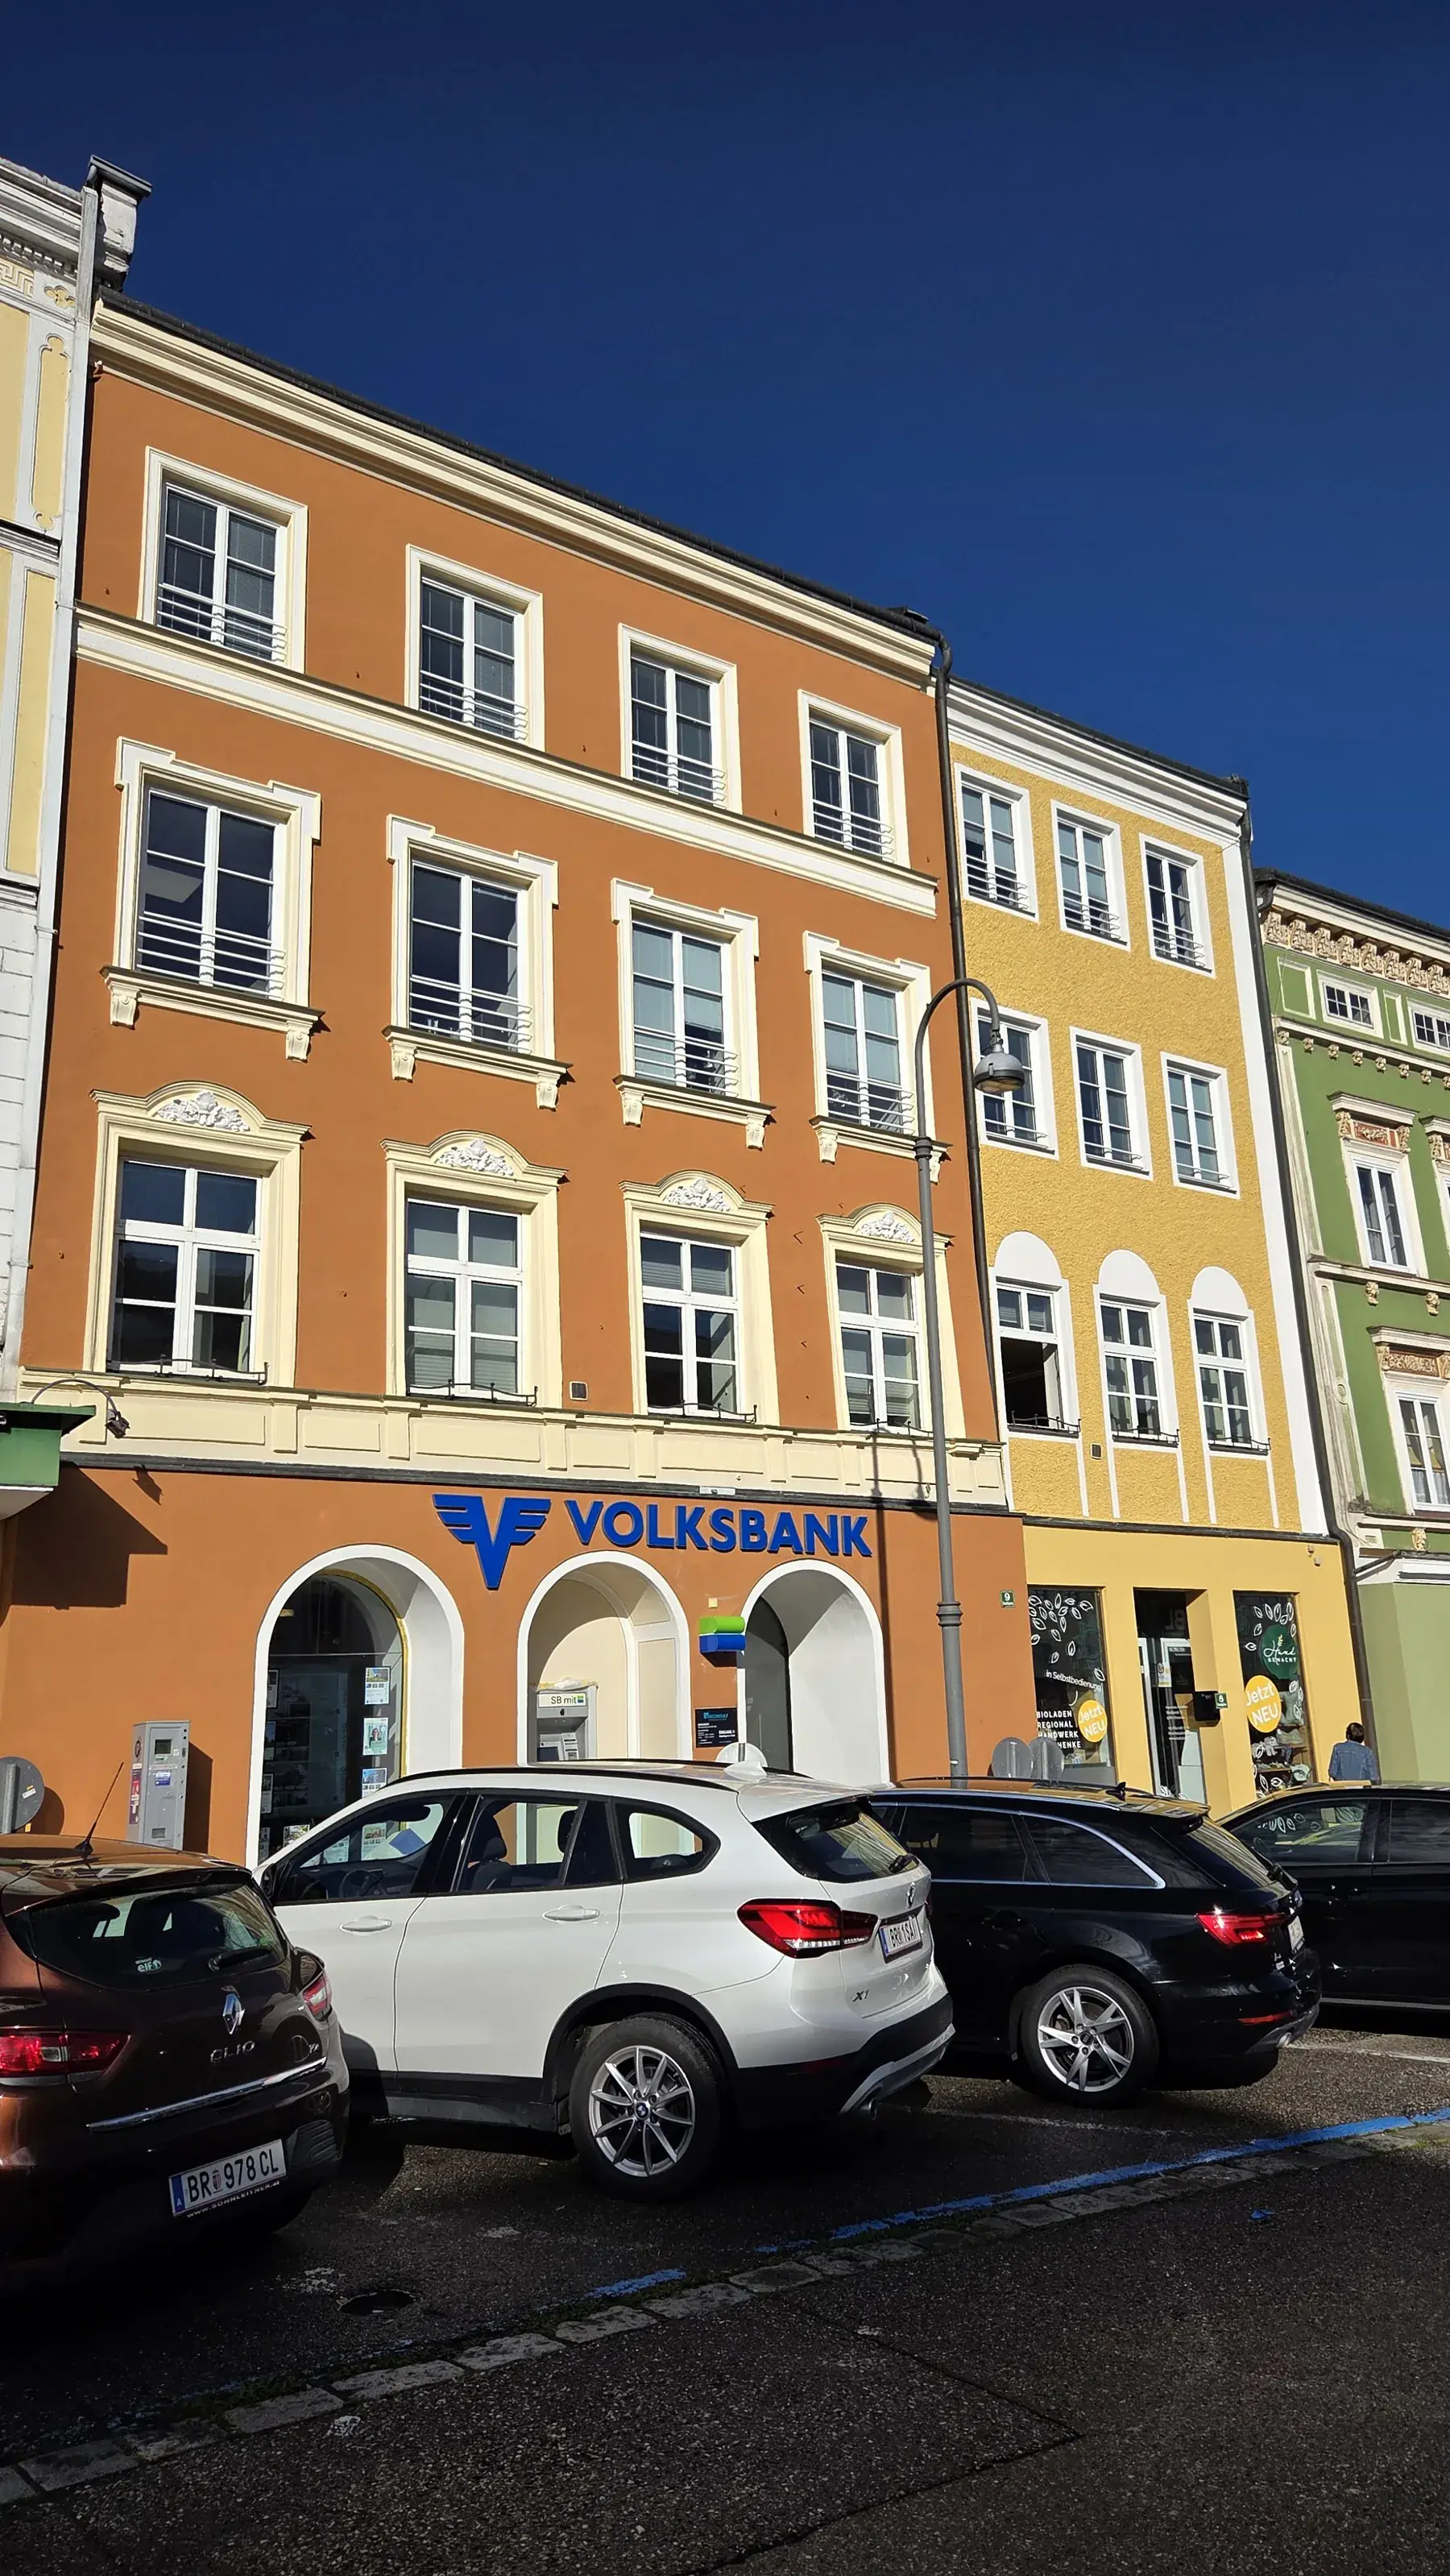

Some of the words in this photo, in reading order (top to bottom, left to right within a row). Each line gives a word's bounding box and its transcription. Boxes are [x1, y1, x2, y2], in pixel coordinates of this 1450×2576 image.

[564, 1500, 872, 1557] VOLKSBANK
[1004, 1591, 1011, 1601] 9
[1052, 1671, 1102, 1693] Selbstbedienung
[551, 1695, 562, 1705] SB
[564, 1695, 577, 1704] mit
[1245, 1682, 1275, 1707] Jetzt
[1036, 1710, 1073, 1719] BIOLADEN
[1079, 1703, 1103, 1724] Jetzt
[1251, 1701, 1279, 1727] NEU
[1037, 1720, 1074, 1729] REGIONAL
[1083, 1719, 1105, 1737] NEU
[1057, 1740, 1082, 1749] HENKE
[137, 1960, 152, 1972] elf
[852, 1989, 870, 2002] X1
[209, 2040, 255, 2064] CLIO
[187, 2171, 212, 2203] BR
[186, 2180, 280, 2218] www.SONNLEITNER.at
